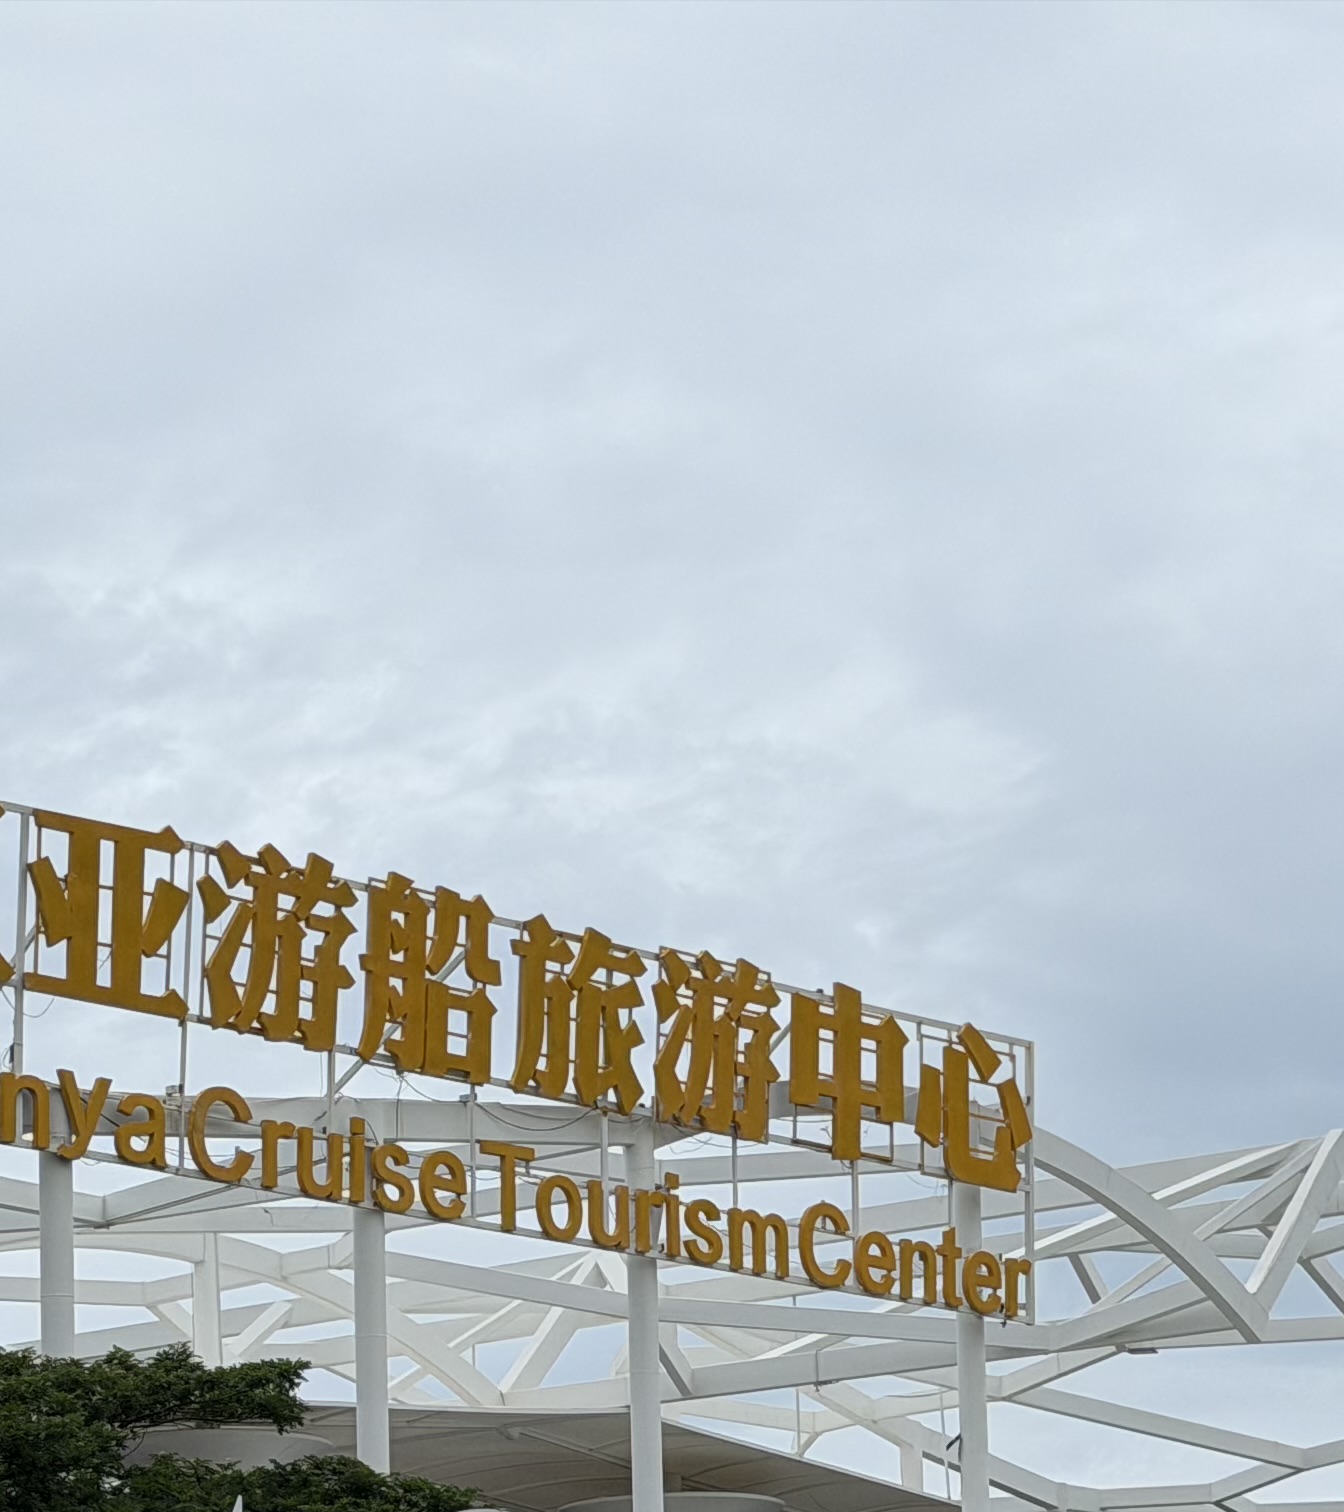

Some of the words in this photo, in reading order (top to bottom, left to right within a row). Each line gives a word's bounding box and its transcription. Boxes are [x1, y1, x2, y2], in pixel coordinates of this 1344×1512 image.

[187, 1086, 468, 1222] Cruise
[479, 1140, 789, 1279] Tourism
[797, 1200, 1031, 1318] Center
